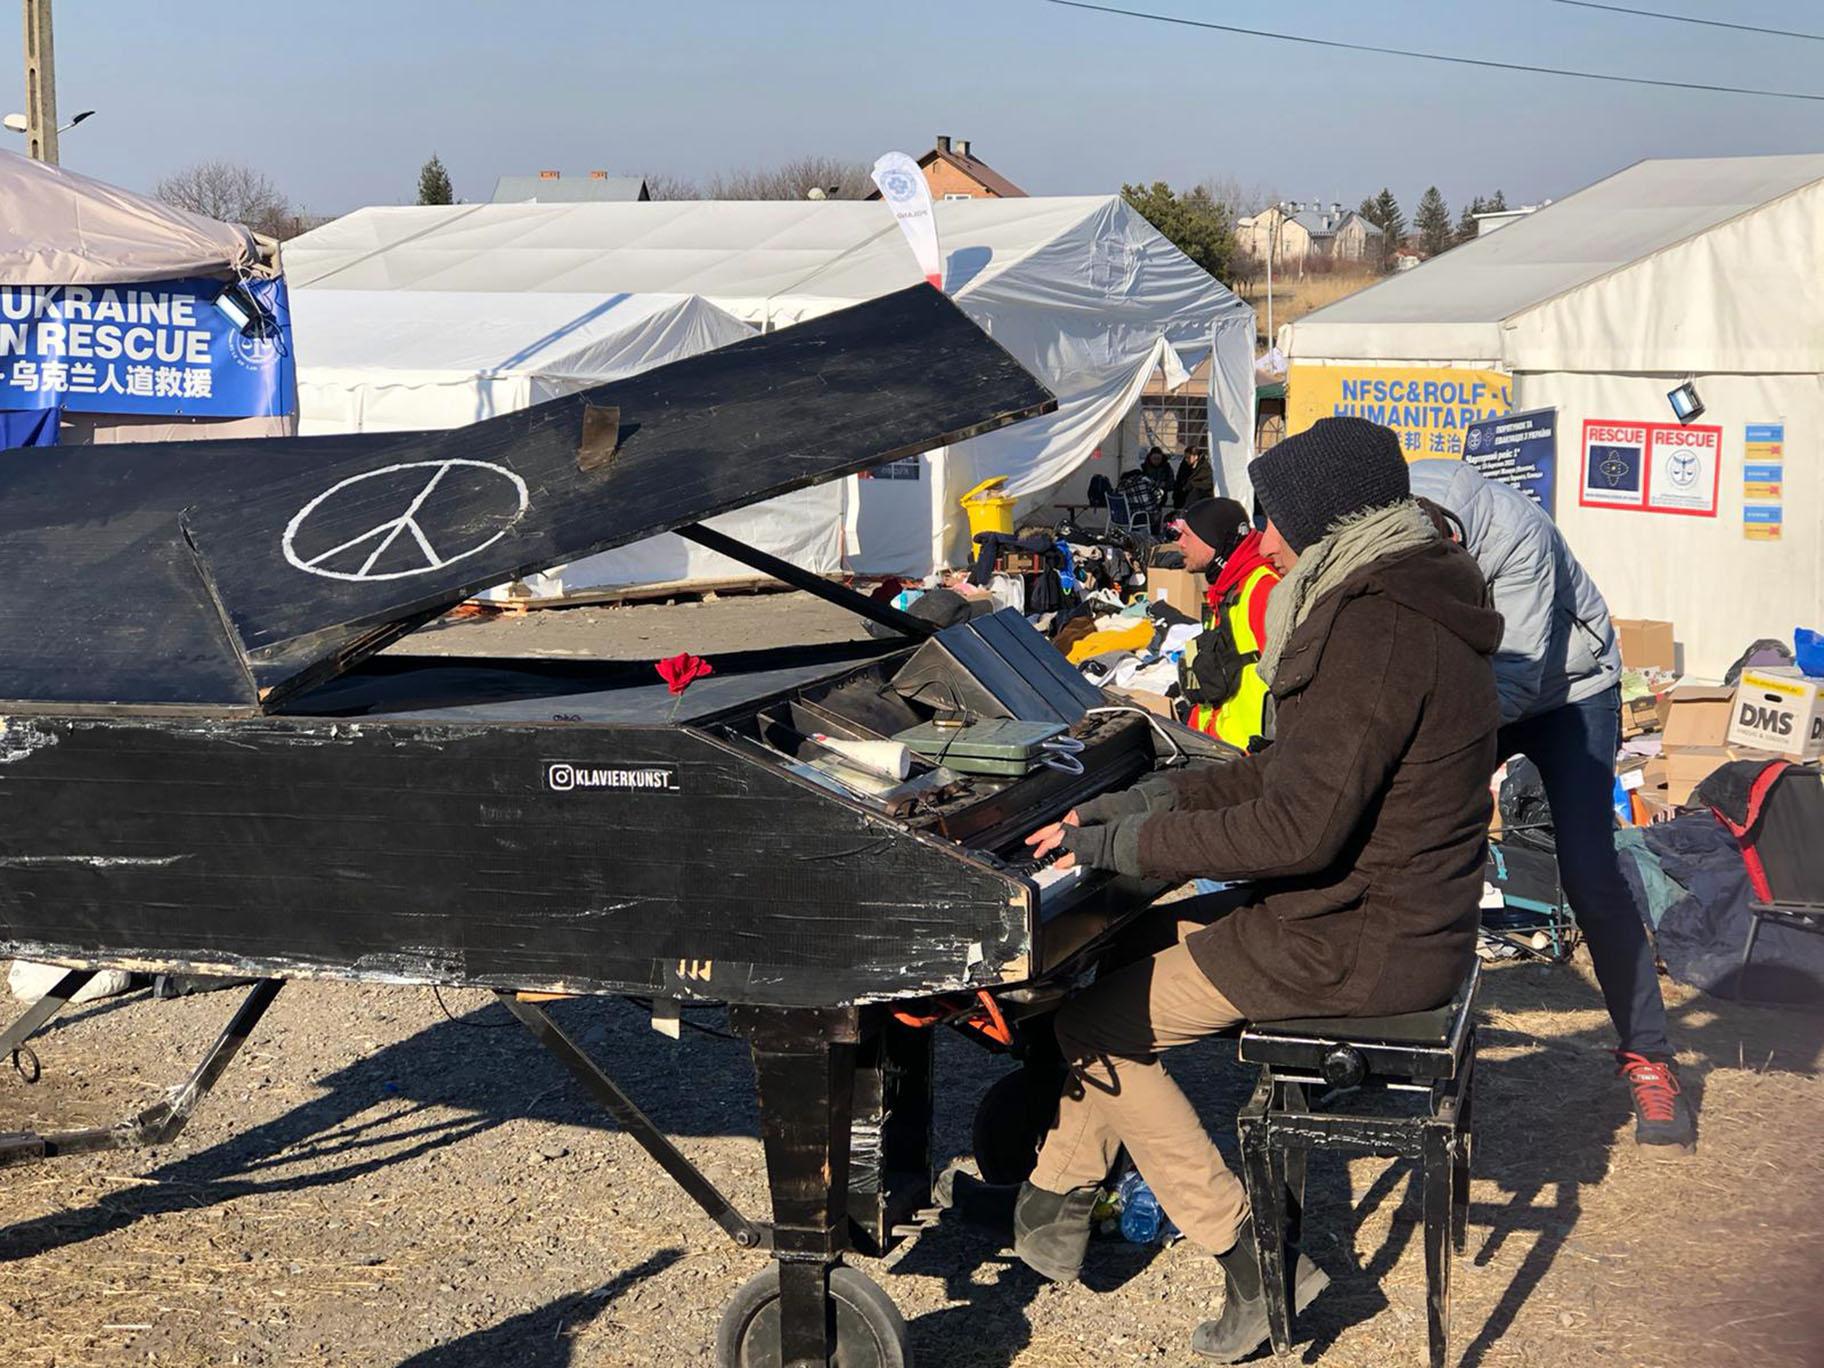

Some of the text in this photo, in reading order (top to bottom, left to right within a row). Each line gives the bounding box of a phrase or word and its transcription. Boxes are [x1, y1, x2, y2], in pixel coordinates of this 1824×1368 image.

[2, 286, 196, 326] UKRAINE
[37, 322, 211, 364] RESCUE
[1342, 380, 1486, 405] NFSC&ROLF
[1398, 431, 1421, 451] 邦
[1589, 428, 1643, 444] RESCUE
[1655, 431, 1715, 448] RESCUE
[1739, 703, 1794, 735] DMS
